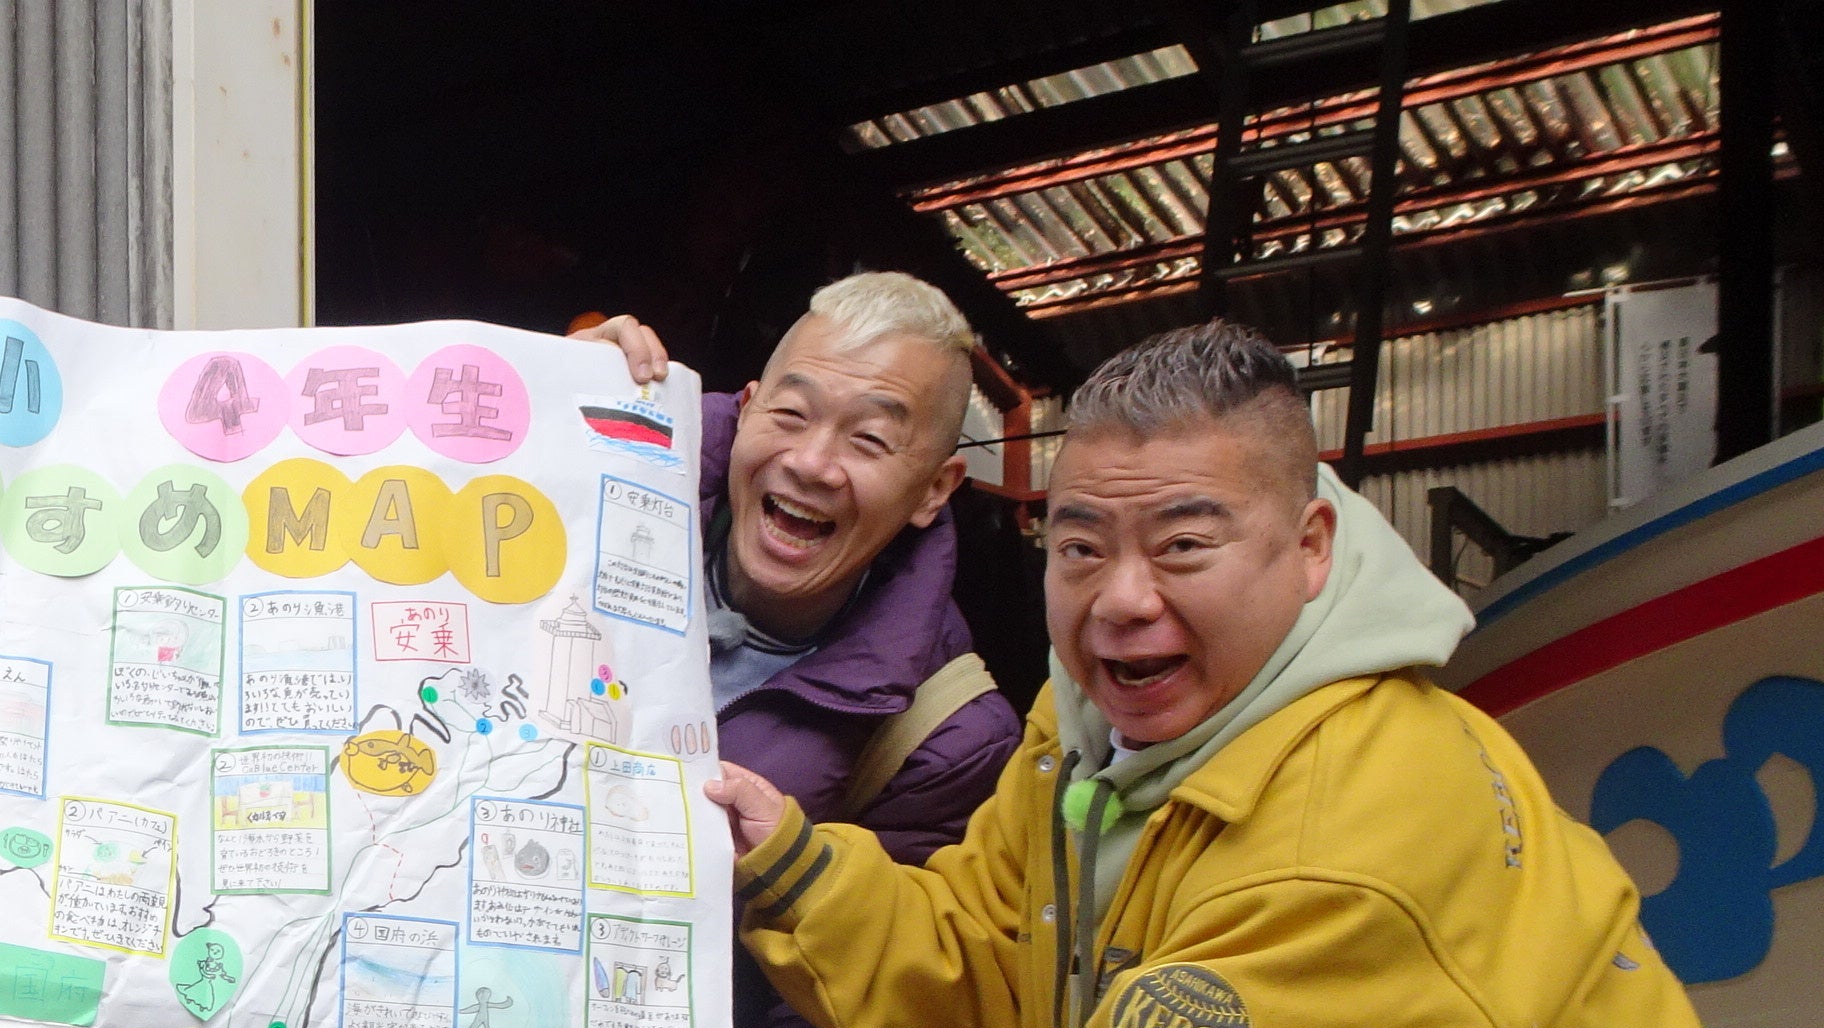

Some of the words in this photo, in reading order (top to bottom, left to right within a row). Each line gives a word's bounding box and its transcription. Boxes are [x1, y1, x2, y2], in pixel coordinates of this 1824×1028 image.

[184, 354, 513, 442] 4年生
[265, 477, 535, 578] MAP
[389, 619, 460, 658] 安乗
[405, 606, 450, 622] あのり
